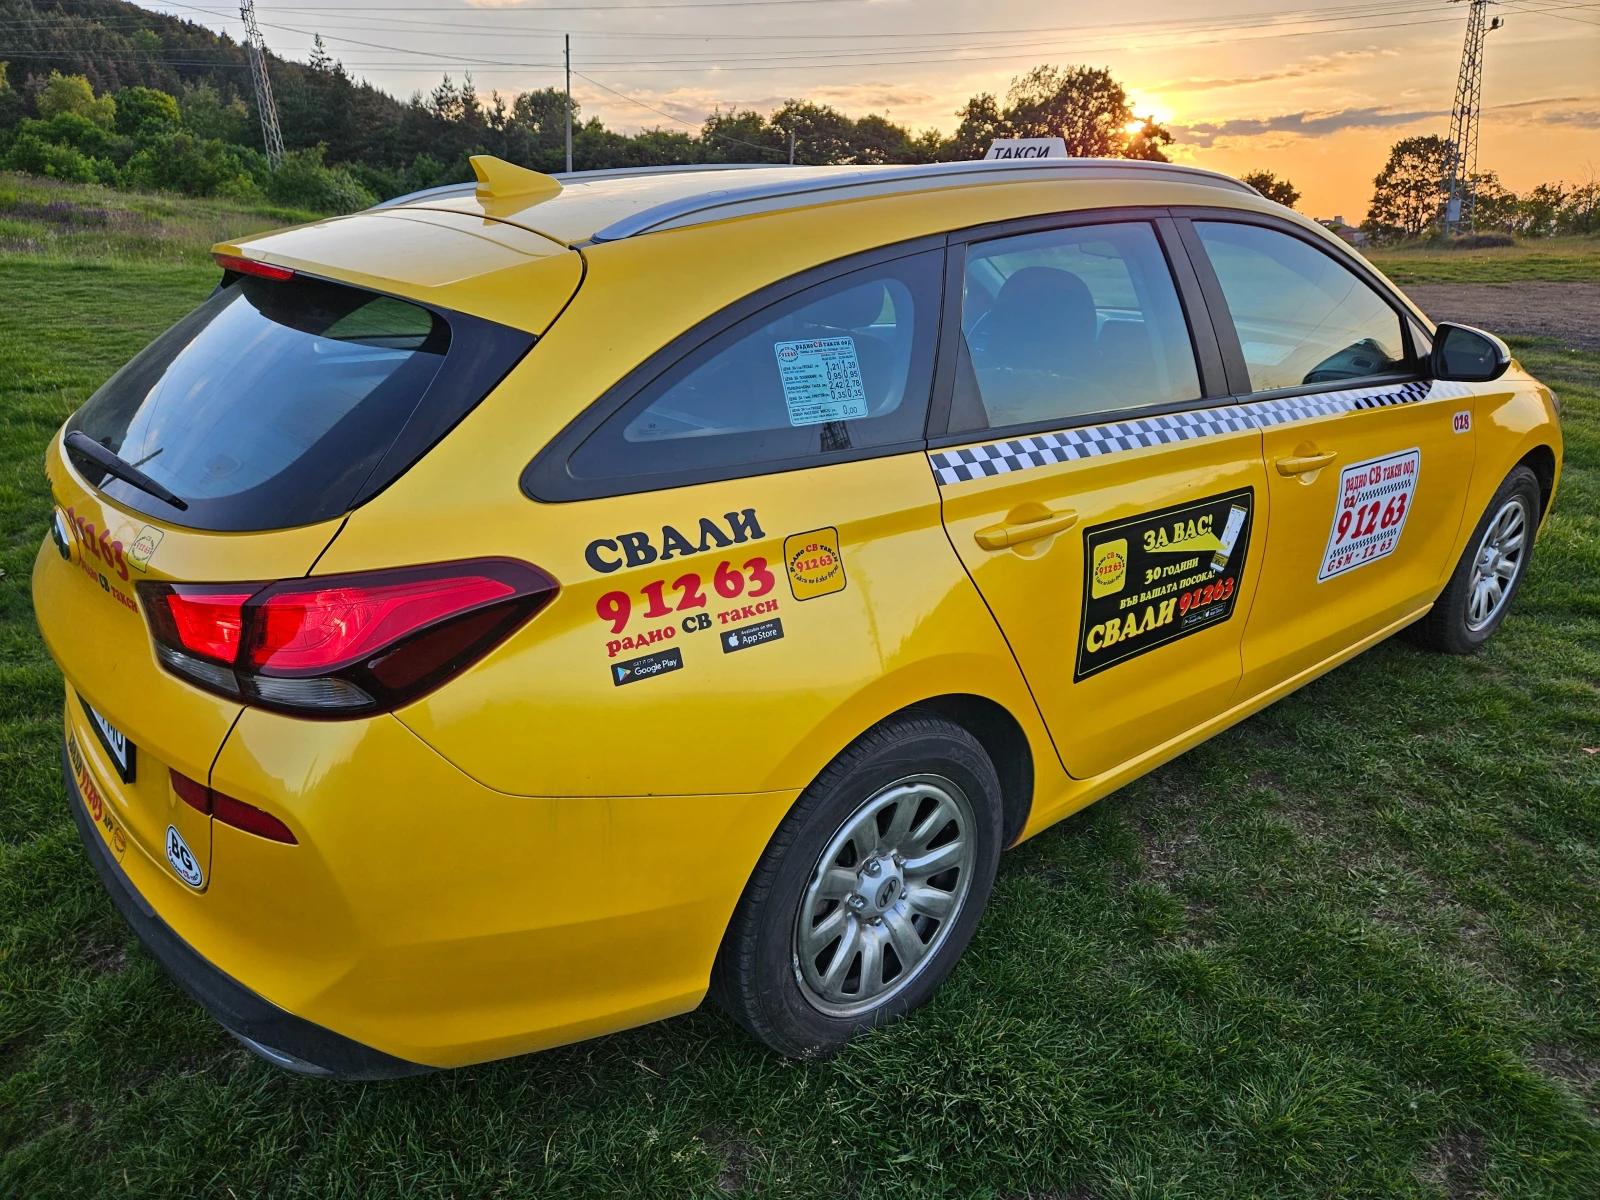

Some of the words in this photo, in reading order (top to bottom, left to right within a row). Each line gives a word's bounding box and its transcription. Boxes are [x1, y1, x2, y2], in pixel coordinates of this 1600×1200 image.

[994, 146, 1050, 159] ТАКСИ
[1454, 414, 1470, 431] 028
[1345, 473, 1367, 496] радио
[1369, 465, 1381, 485] СВ
[1383, 463, 1402, 481] такси
[1403, 460, 1415, 477] оод
[585, 508, 765, 573] СВАЛИ
[805, 543, 818, 552] СВ
[1144, 527, 1169, 551] ЗА
[1173, 514, 1213, 544] ВАС!
[1144, 566, 1162, 585] 30
[1162, 557, 1199, 578] ГОДИНИ
[1327, 552, 1354, 572] GSM
[98, 573, 110, 593] СВ
[111, 585, 138, 614] такси
[1119, 595, 1139, 610] ВЪВ
[1139, 581, 1178, 603] ВАШАТА
[1179, 569, 1216, 589] ПОСОКА!
[1179, 577, 1234, 616] 91263
[605, 626, 676, 657] радио
[682, 612, 713, 633] СВ
[717, 598, 779, 624] такси
[742, 633, 758, 645] App
[758, 628, 777, 640] Store
[1086, 597, 1178, 653] СВАЛИ
[634, 662, 661, 676] Google
[661, 657, 677, 669] Play
[172, 831, 193, 871] BG
